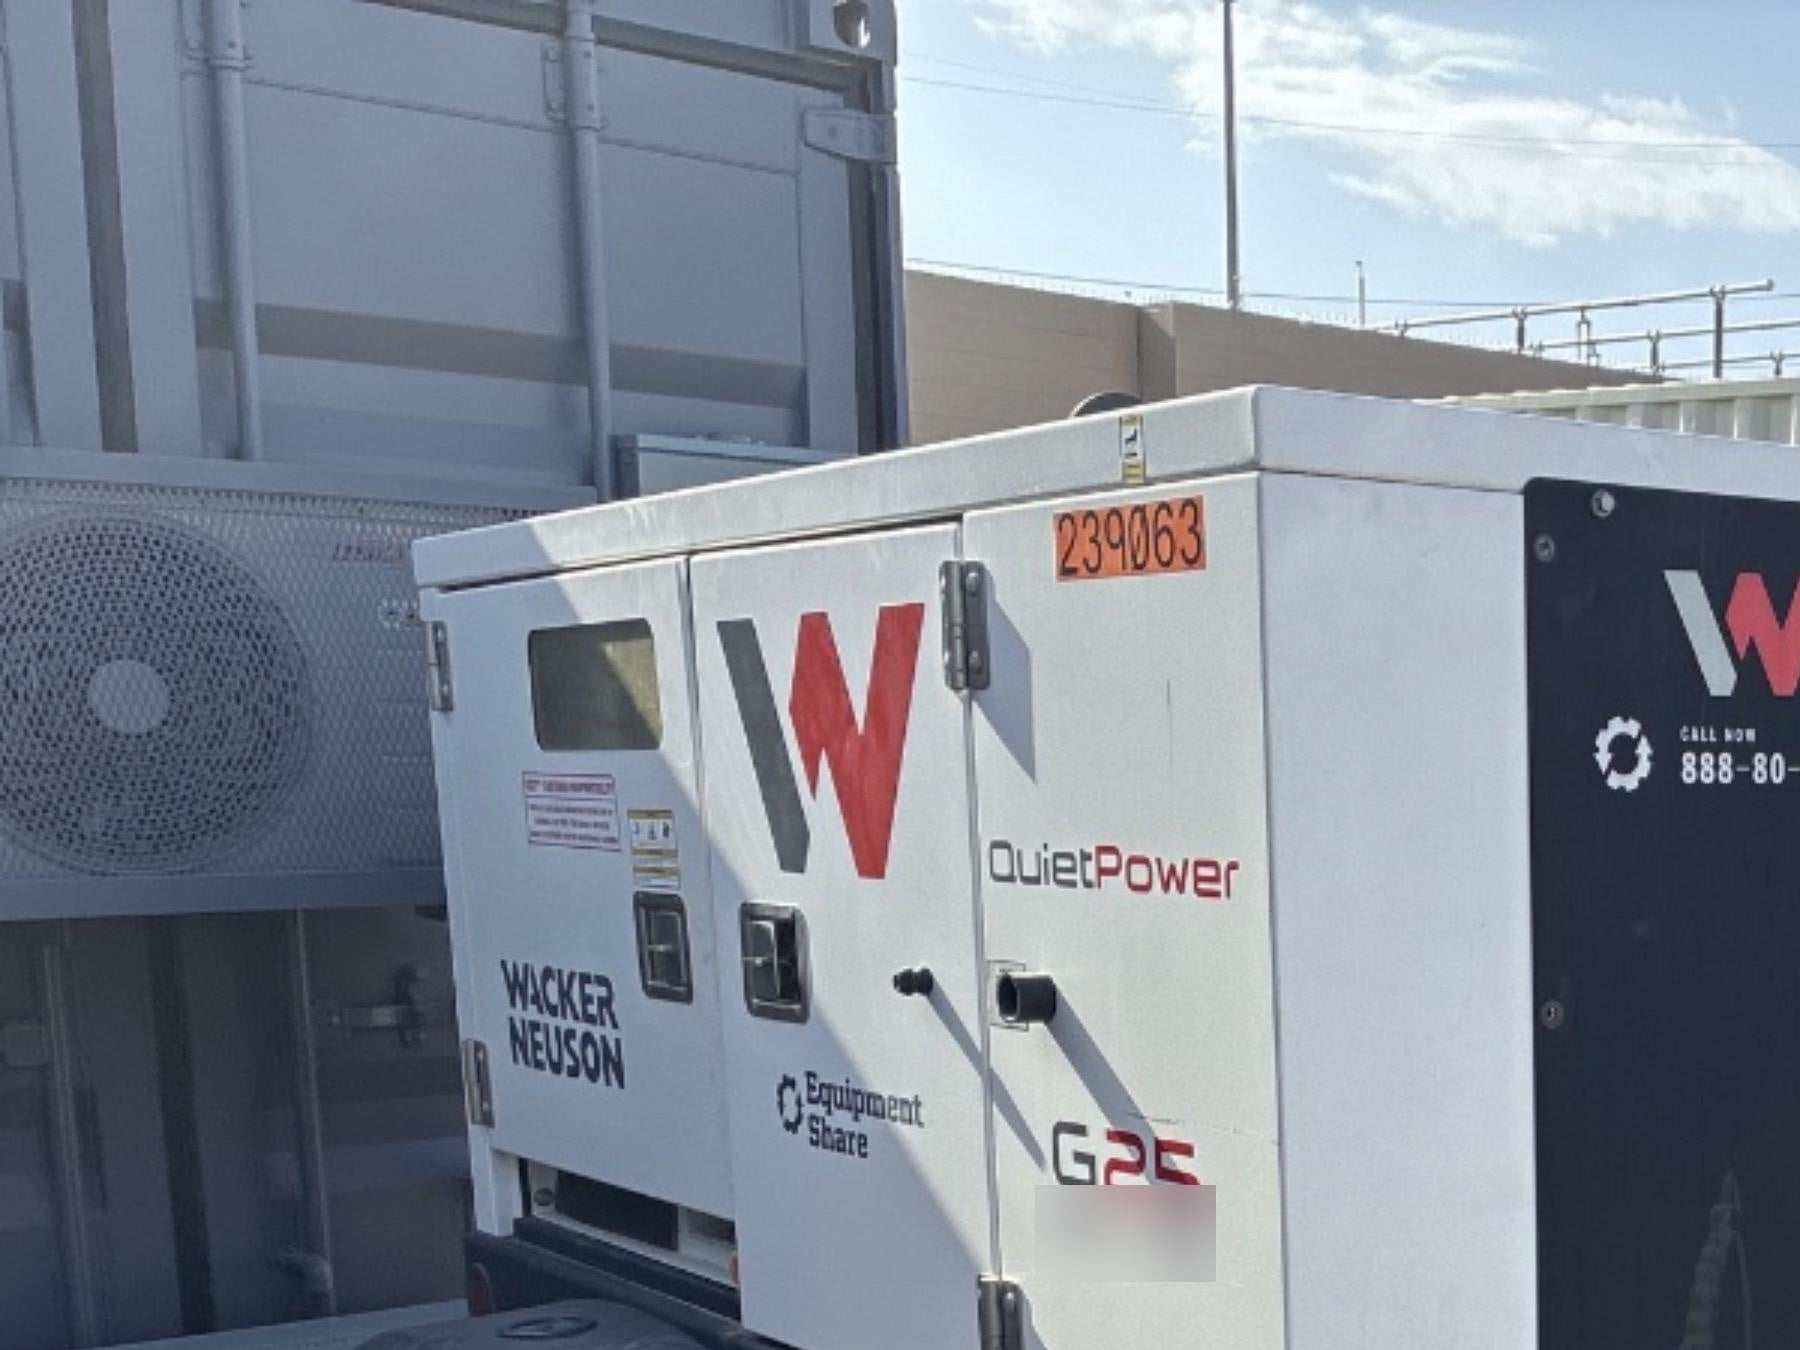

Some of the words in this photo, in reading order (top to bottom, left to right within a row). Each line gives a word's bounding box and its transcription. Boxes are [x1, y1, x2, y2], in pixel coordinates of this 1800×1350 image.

[1057, 499, 1204, 577] 239063
[1679, 725, 1717, 742] CALL
[989, 839, 1240, 900] QuietPower
[500, 958, 620, 1031] WACKER
[508, 1016, 626, 1090] NEUSON
[804, 1070, 925, 1128] Equipment
[808, 1114, 868, 1159] Share
